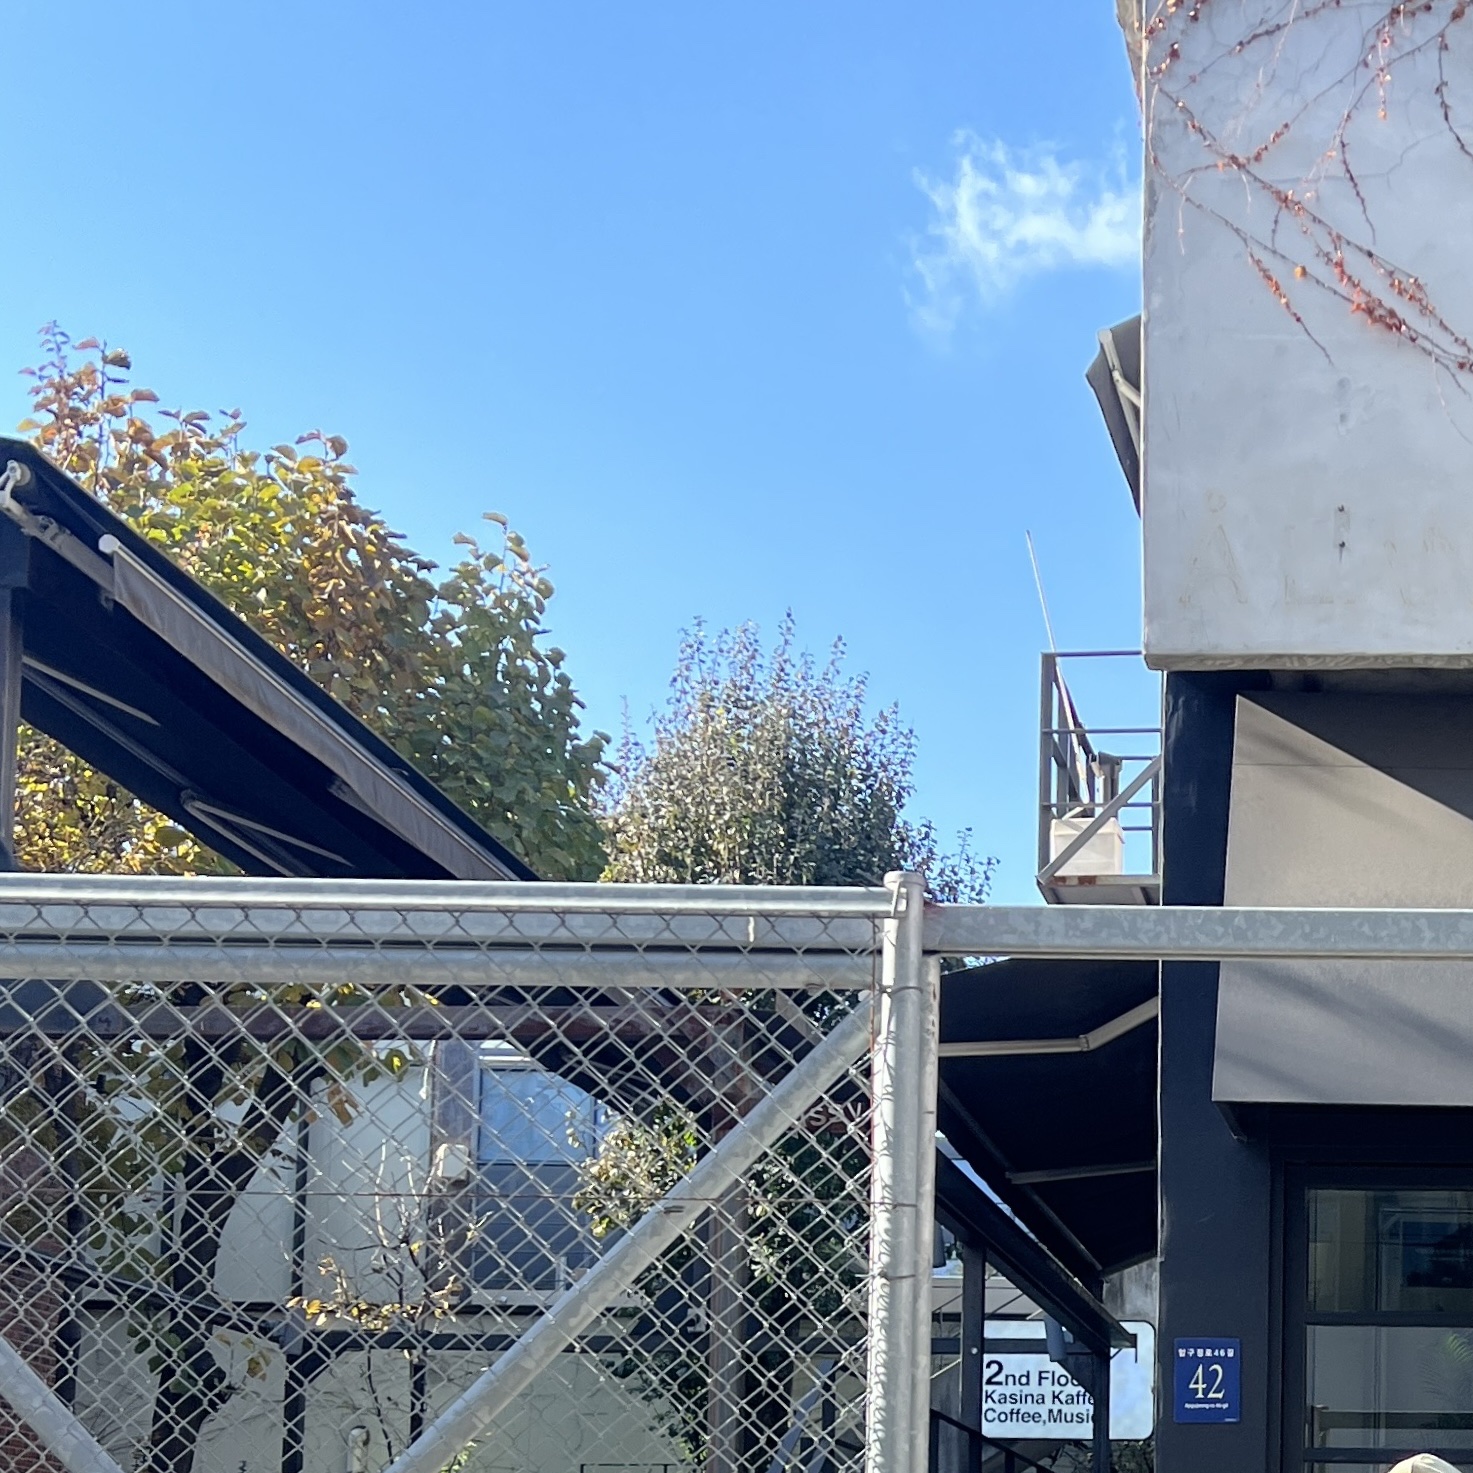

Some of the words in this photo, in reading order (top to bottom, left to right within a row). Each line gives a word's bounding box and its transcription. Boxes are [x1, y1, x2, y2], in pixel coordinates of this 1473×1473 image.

[985, 1360, 1030, 1386] 2nd
[1188, 1363, 1226, 1400] 42
[984, 1390, 1046, 1405] Kasina
[1051, 1390, 1094, 1405] Kaffe
